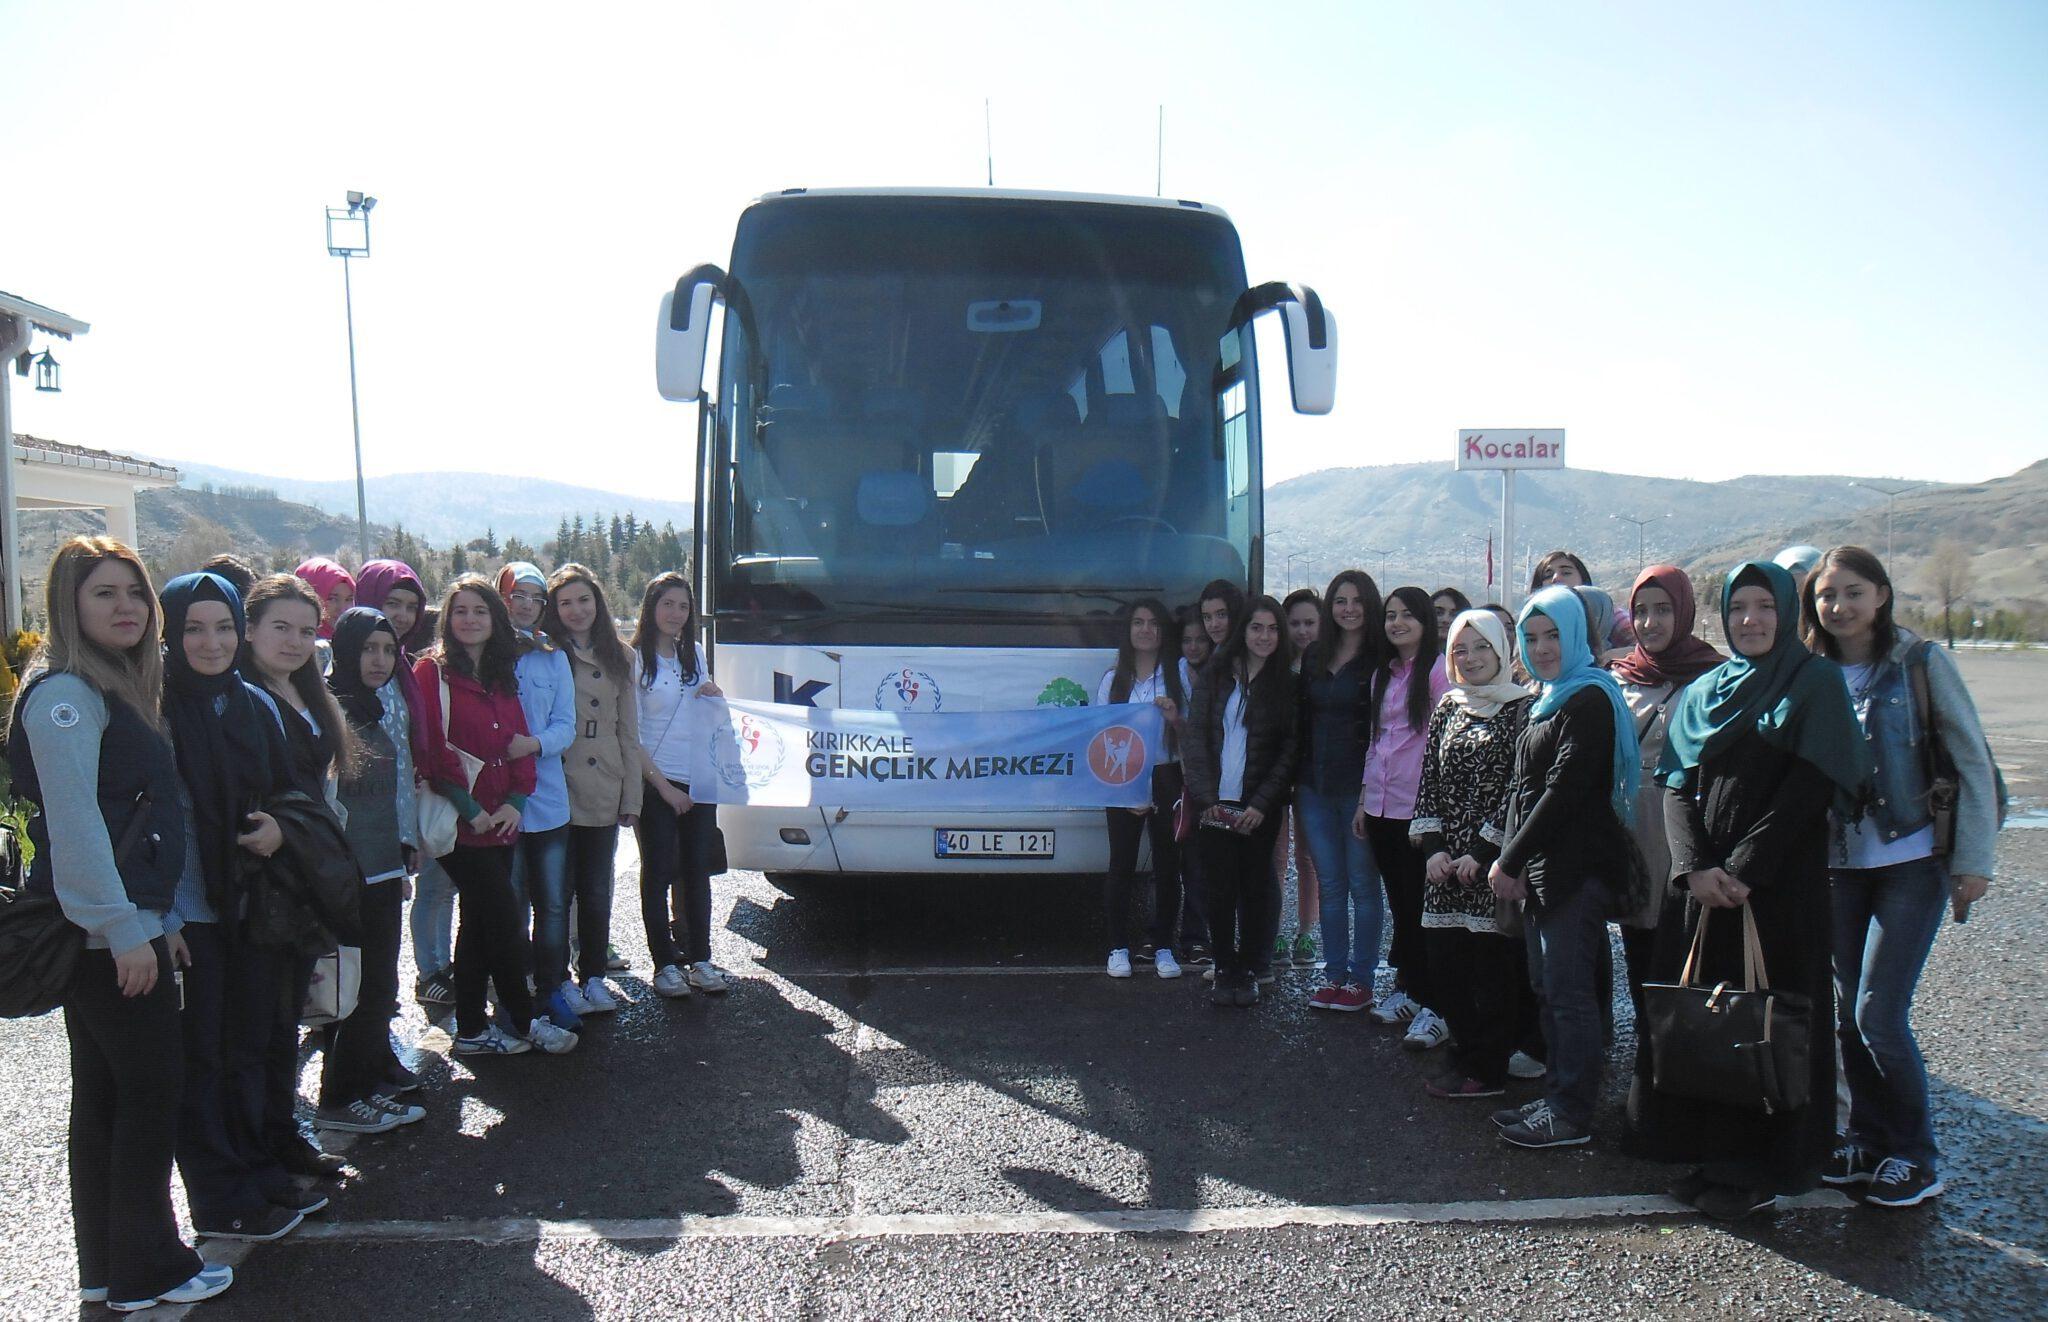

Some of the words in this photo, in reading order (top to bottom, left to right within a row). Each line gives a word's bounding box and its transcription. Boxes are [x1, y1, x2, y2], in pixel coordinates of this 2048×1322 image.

[1465, 435, 1560, 460] Kocalar
[806, 730, 914, 753] KIRIKKALE
[948, 834, 969, 851] 40
[982, 835, 1003, 851] LE
[1019, 834, 1047, 851] 121
